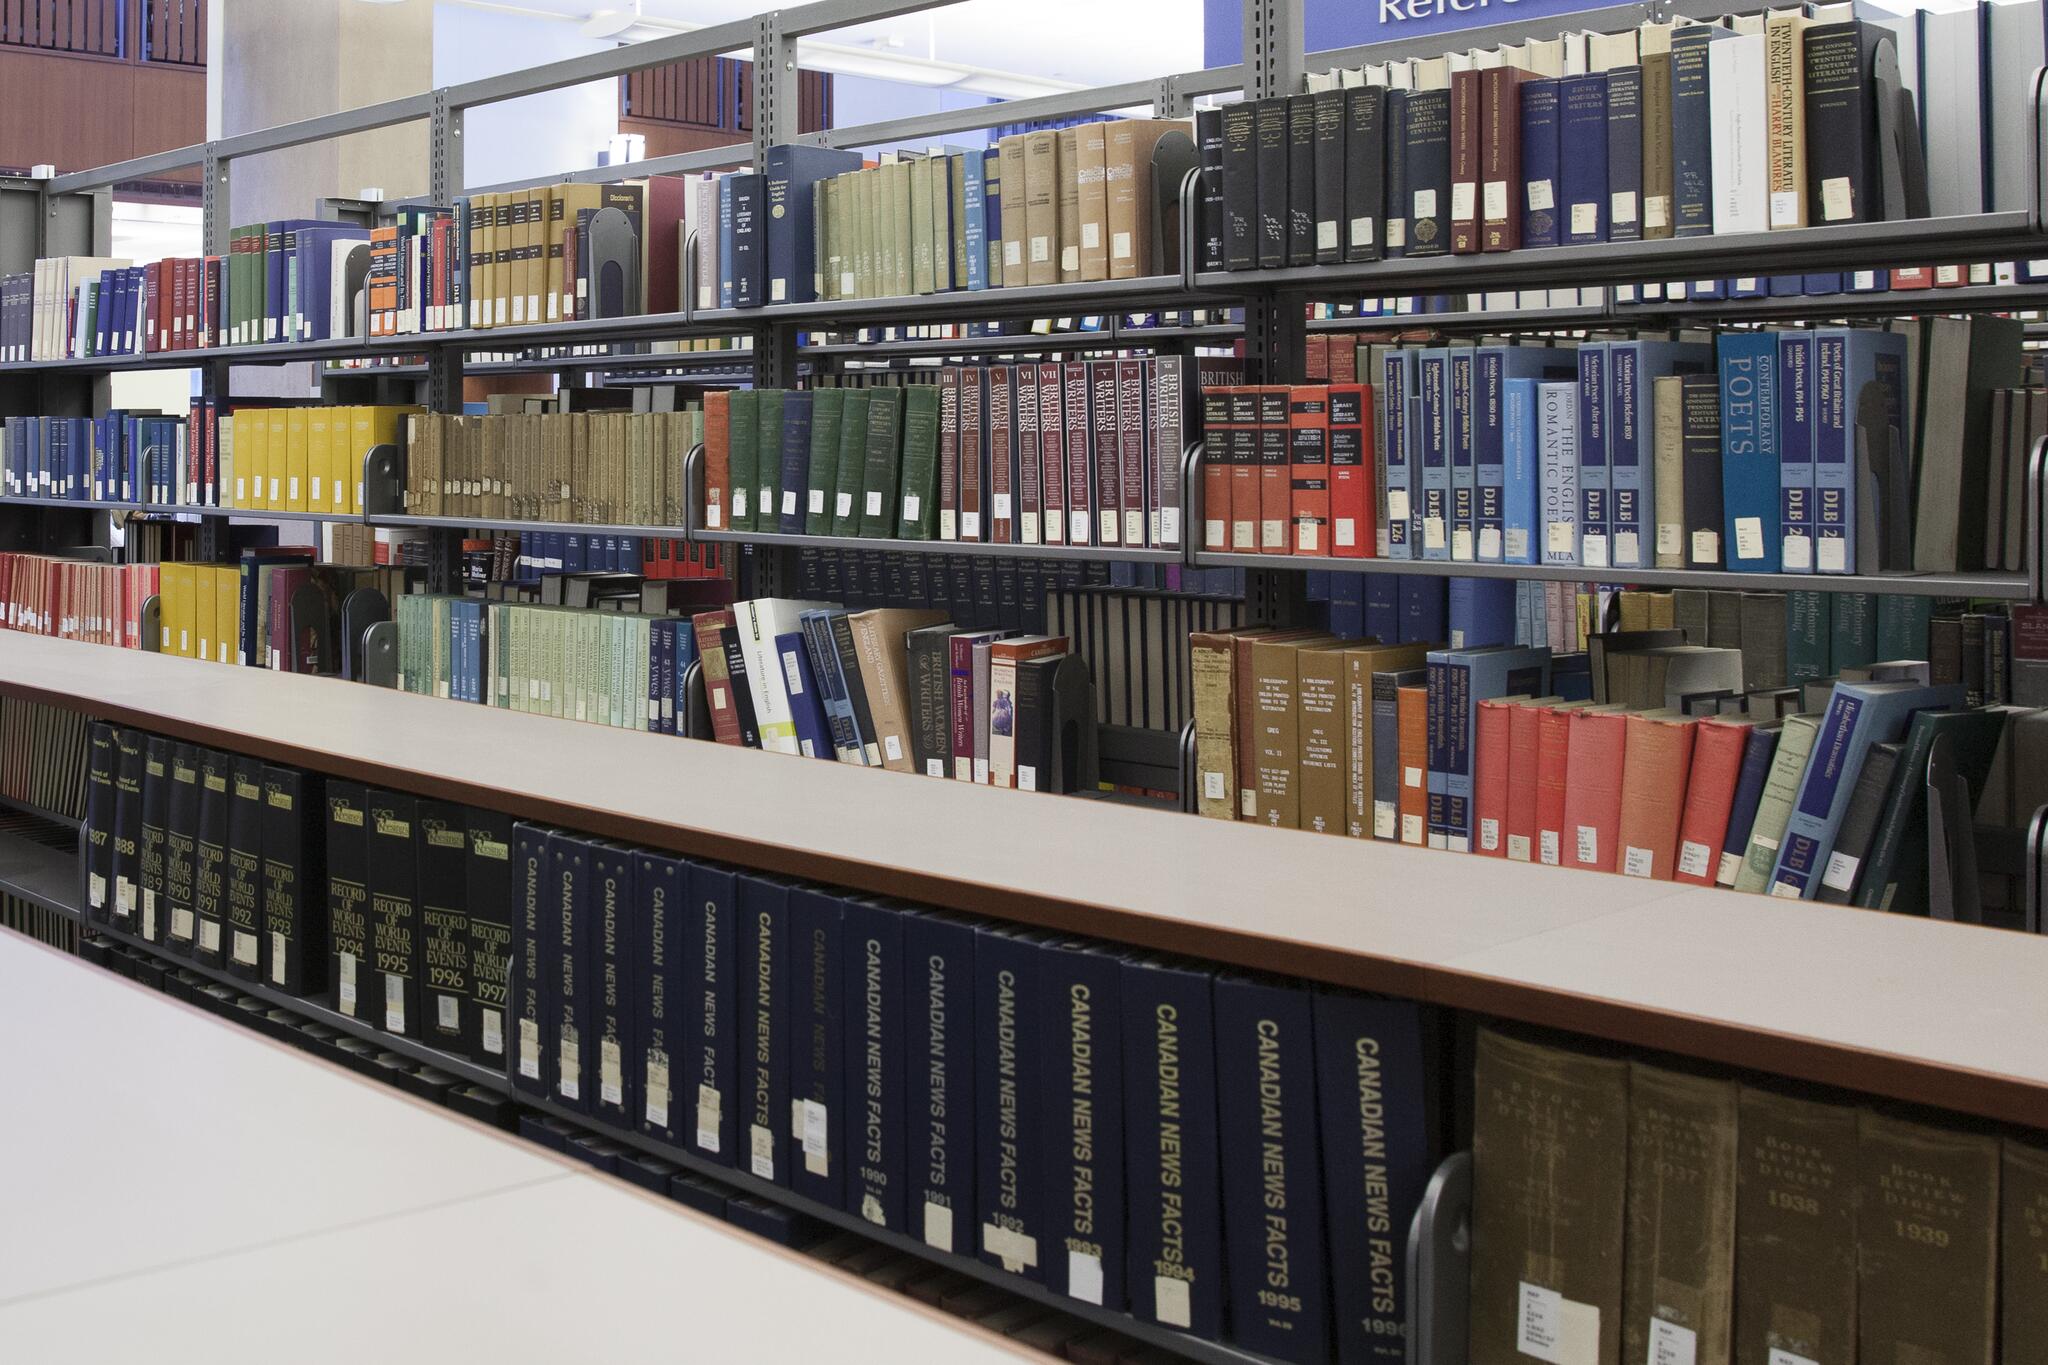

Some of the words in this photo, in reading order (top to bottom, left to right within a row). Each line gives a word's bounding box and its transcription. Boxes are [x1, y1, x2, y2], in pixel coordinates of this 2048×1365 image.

[1770, 26, 1782, 37] IN
[1770, 39, 1782, 84] ENGLISH
[1808, 67, 1859, 79] LITERATURE
[1814, 62, 1850, 70] CENTURY
[1406, 104, 1448, 112] LITERATURE
[1410, 97, 1442, 105] ENGLISH
[1568, 101, 1602, 110] WRITERS
[1772, 100, 1782, 137] HARRY
[1409, 127, 1442, 135] CENTURY
[1772, 139, 1782, 192] BLAMIRES
[1782, 140, 1794, 192] LITERATU
[1833, 342, 1842, 362] Poets
[1200, 370, 1244, 385] BRITISH
[1624, 384, 1632, 402] Poets
[1833, 370, 1842, 388] Great
[948, 387, 957, 433] BRITISH
[962, 386, 970, 431] WRITERS
[970, 385, 978, 430] BRITISH
[992, 384, 1000, 430] WRITERS
[1000, 384, 1008, 429] BRITISH
[1019, 386, 1028, 432] WRITERS
[1027, 385, 1037, 432] BRITISH
[1042, 384, 1050, 432] WRITERS
[1050, 384, 1060, 431] BRITISH
[1068, 380, 1077, 431] WRITERS
[1076, 379, 1086, 430] BRITISH
[1096, 380, 1106, 432] WRITERS
[1104, 380, 1116, 431] BRITISH
[1122, 380, 1132, 432] WRITERS
[1131, 379, 1141, 431] BRITISH
[1159, 375, 1168, 428] WRITERS
[1168, 374, 1179, 428] BRITISH
[1728, 357, 1754, 455] POETS
[1758, 354, 1772, 454] CONTEMPORARY
[1833, 413, 1843, 429] and
[1834, 389, 1842, 412] Britain
[1433, 434, 1441, 451] Poets
[1546, 392, 1558, 480] ROMANTIC
[1562, 425, 1574, 456] THE
[1428, 490, 1440, 518] DLB
[1457, 490, 1469, 518] DLB
[1483, 488, 1496, 516] DLB
[1546, 486, 1558, 527] POET
[1562, 466, 1574, 530] ENGLIS
[1588, 491, 1600, 520] DLB
[1619, 492, 1632, 522] DLB
[1788, 490, 1803, 521] DLB
[1824, 490, 1838, 522] DLB
[932, 651, 944, 700] BRITISH
[920, 673, 934, 732] WRITERS
[935, 704, 947, 754] WOMEN
[1431, 796, 1443, 823] DLB
[1451, 798, 1464, 826] DLB
[230, 853, 257, 872] RECORD
[265, 864, 294, 884] RECORD
[1791, 838, 1812, 869] DLB
[168, 882, 191, 900] 1990
[230, 878, 255, 894] WORLD
[230, 890, 255, 908] EVENTS
[266, 888, 294, 905] WORLD
[331, 882, 366, 902] RECORD
[341, 899, 354, 912] OF
[526, 857, 538, 931] CANADIAN
[232, 906, 252, 925] 1992
[266, 900, 294, 920] EVENTS
[268, 918, 292, 935] 1993
[332, 908, 364, 926] WORLD
[374, 899, 412, 918] RECORD
[385, 914, 398, 926] OF
[424, 911, 468, 930] RECORD
[562, 871, 574, 946] CANADIAN
[604, 878, 616, 956] CANADIAN
[652, 887, 665, 966] CANADIAN
[332, 922, 366, 940] EVENTS
[335, 936, 364, 956] 1994
[375, 923, 410, 942] WORLD
[375, 936, 412, 956] EVENTS
[426, 937, 466, 956] WORLD
[438, 926, 452, 940] OF
[472, 924, 511, 944] RECORD
[484, 940, 498, 954] OF
[704, 901, 717, 983] CANADIAN
[376, 952, 408, 972] 1995
[426, 950, 468, 970] EVENTS
[430, 967, 464, 988] 1996
[473, 950, 508, 972] WORLD
[526, 938, 537, 980] NEWS
[563, 954, 574, 998] NEWS
[758, 912, 772, 1006] CANADIAN
[477, 981, 506, 1002] 1997
[604, 963, 616, 1008] NEWS
[652, 974, 664, 1020] NEWS
[866, 938, 882, 1038] CANADIAN
[928, 955, 945, 1057] CANADIAN
[704, 990, 716, 1038] NEWS
[998, 970, 1016, 1076] CANADIAN
[757, 1010, 771, 1064] NEWS
[1070, 984, 1092, 1094] CANADIAN
[866, 1041, 882, 1098] NEWS
[1156, 1004, 1180, 1118] CANADIAN
[1256, 1018, 1284, 1138] CANADIAN
[756, 1068, 770, 1127] FACTS
[930, 1060, 946, 1118] NEWS
[1000, 1080, 1016, 1138] NEWS
[1354, 1036, 1386, 1160] CANADIAN
[866, 1101, 882, 1162] FACTS
[1072, 1098, 1094, 1162] NEWS
[930, 1122, 946, 1186] FACTS
[1160, 1122, 1182, 1188] NEWS
[858, 1166, 888, 1186] 1990
[1000, 1142, 1017, 1208] FACTS
[1262, 1142, 1286, 1210] NEWS
[1072, 1165, 1094, 1235] FACTS
[1364, 1164, 1390, 1234] NEWS
[1768, 1188, 1820, 1216] 1938
[992, 1212, 1024, 1234] 1992
[1160, 1191, 1184, 1264] FACTS
[1894, 1220, 1950, 1248] 1939
[1153, 1260, 1195, 1283] 1994
[1265, 1214, 1288, 1288] FACTS
[1368, 1236, 1396, 1314] FACTS
[1258, 1290, 1301, 1313] 1995
